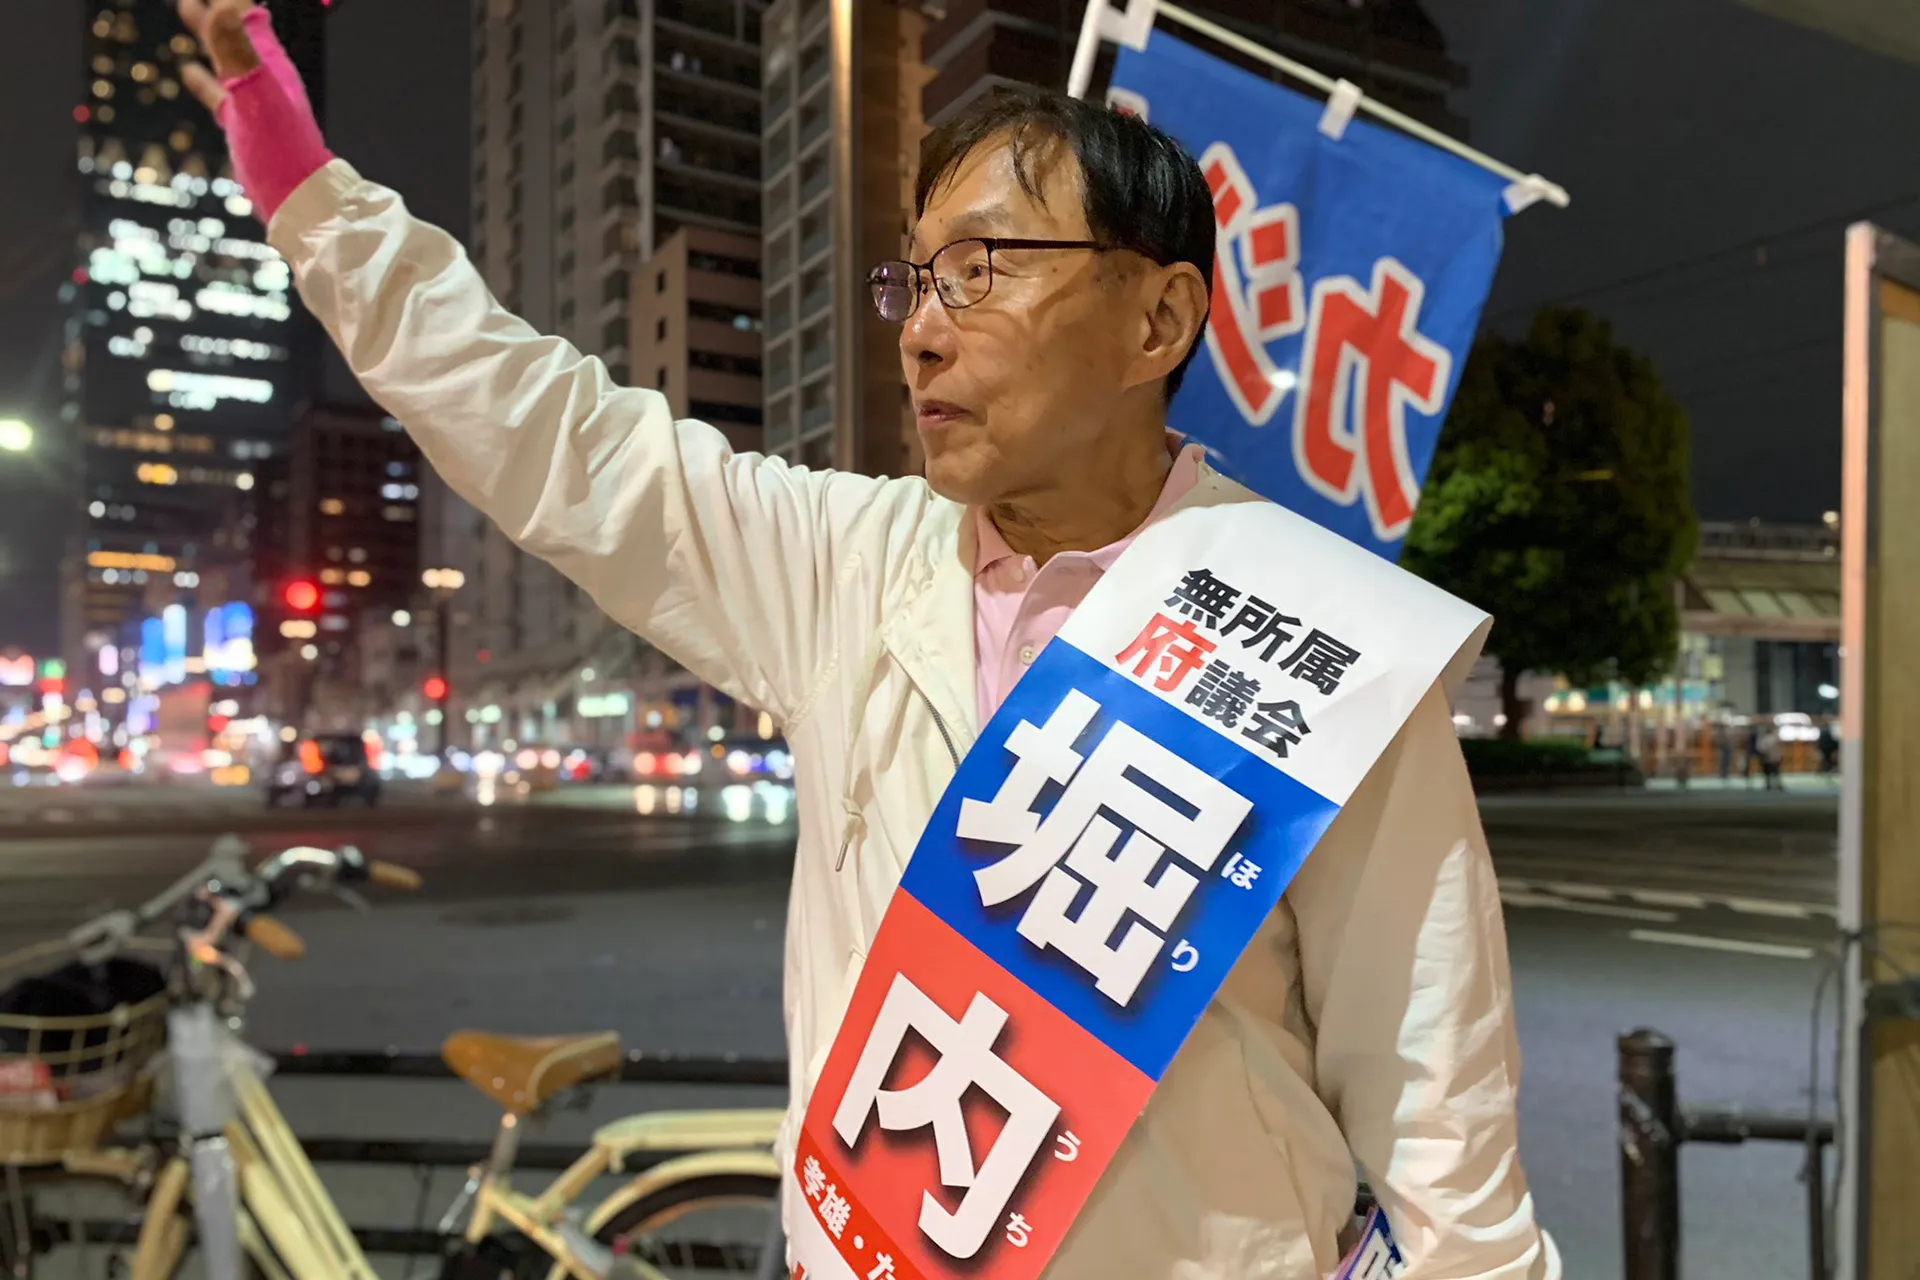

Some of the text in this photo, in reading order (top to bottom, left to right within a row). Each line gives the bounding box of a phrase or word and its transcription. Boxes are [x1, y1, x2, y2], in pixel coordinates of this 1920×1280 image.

[1115, 612, 1311, 758] 府議会
[1164, 568, 1361, 696] 無所属
[832, 688, 1254, 1259] 堀内
